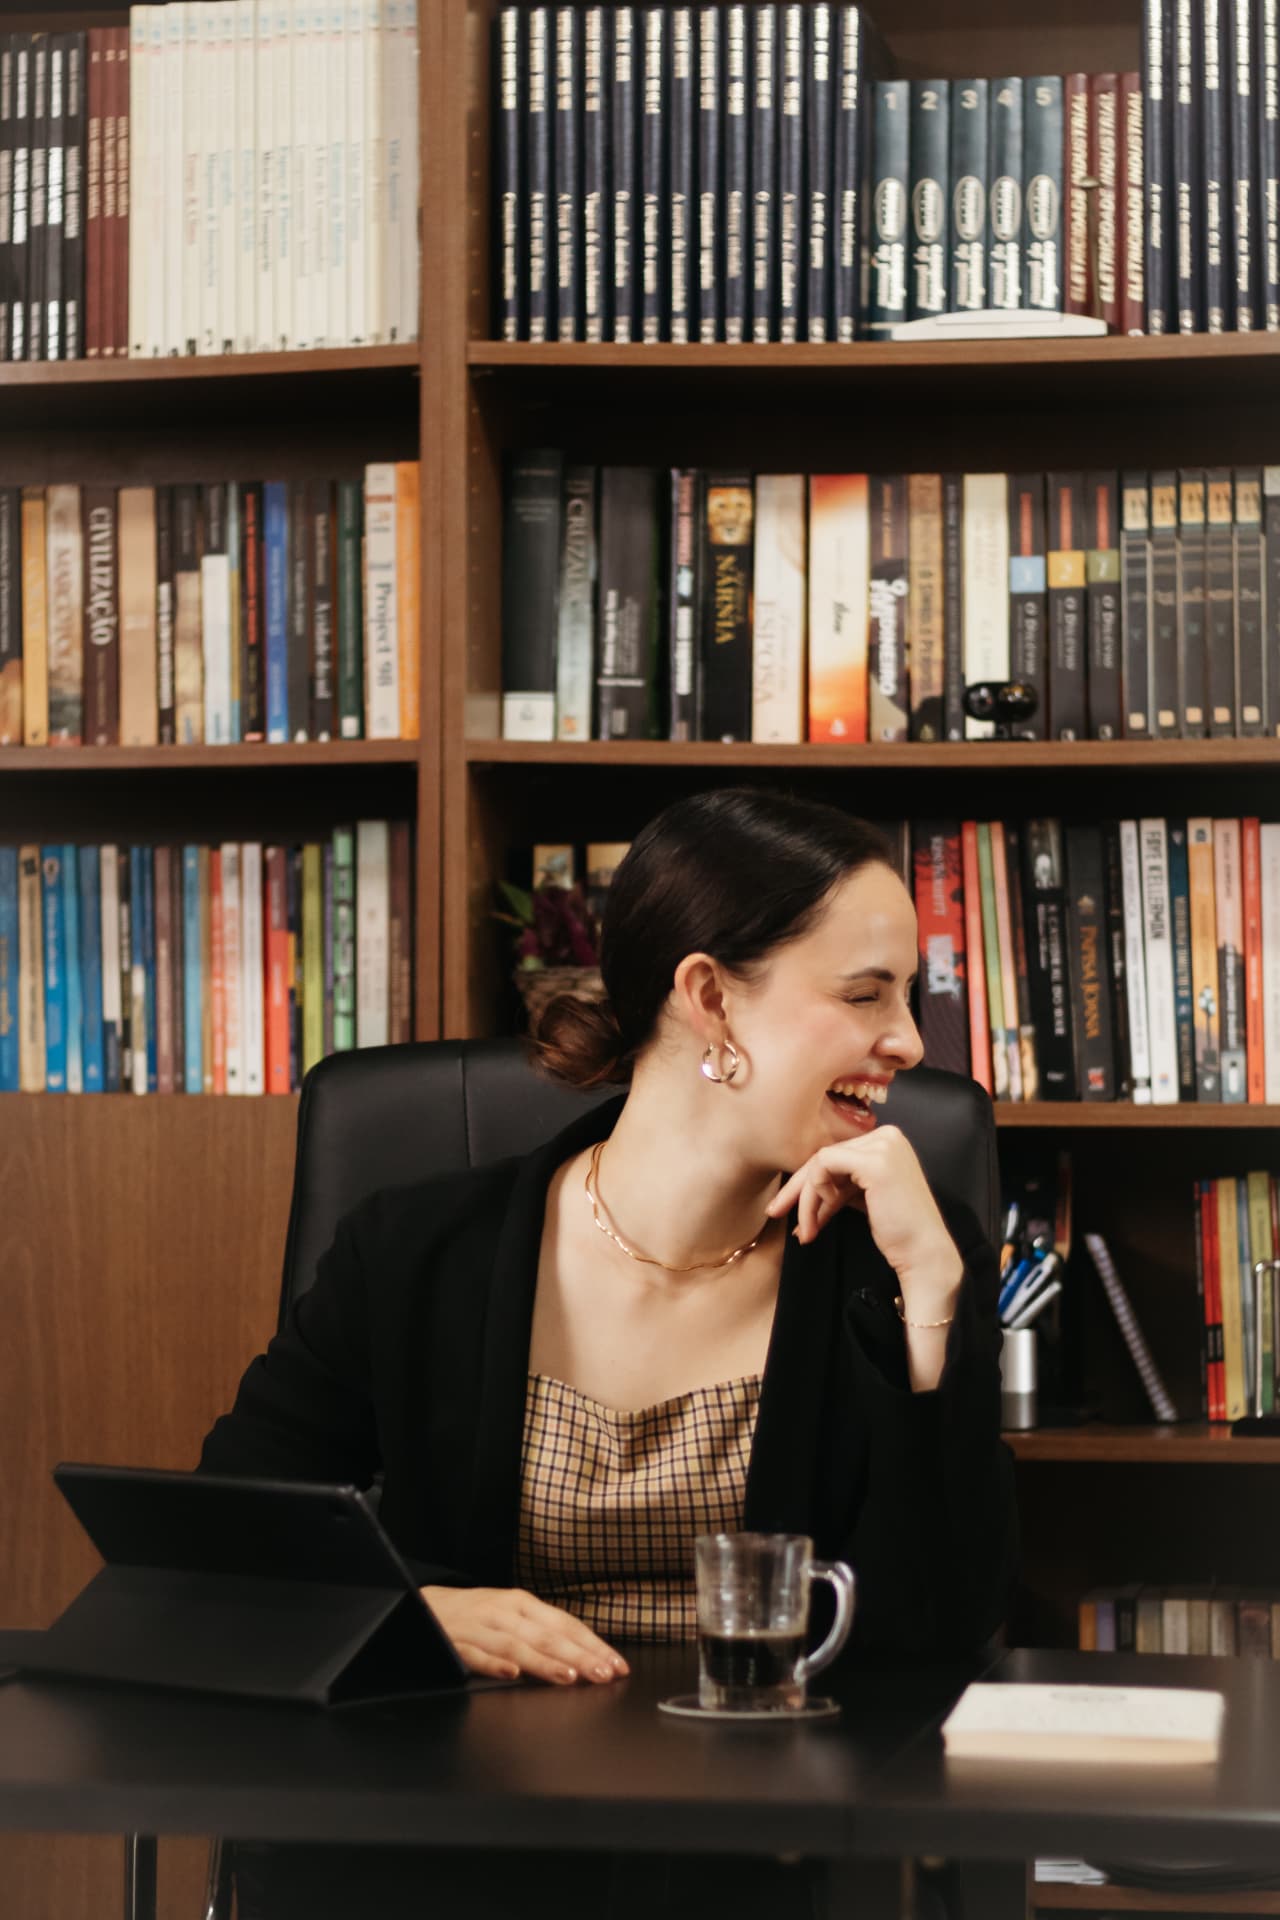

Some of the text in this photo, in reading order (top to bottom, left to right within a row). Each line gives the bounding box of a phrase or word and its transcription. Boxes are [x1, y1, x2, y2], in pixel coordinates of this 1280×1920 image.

[884, 92, 898, 110] 1
[920, 91, 939, 110] 2
[960, 90, 978, 110] 3
[996, 88, 1015, 108] 4
[1035, 88, 1053, 108] 5
[87, 507, 117, 646] CIVILIZAÇÃO
[368, 582, 394, 654] Project
[755, 600, 777, 705] ESPOSA
[1144, 831, 1166, 940] FAYE KELLERMAN
[1079, 925, 1098, 980] PAPISA
